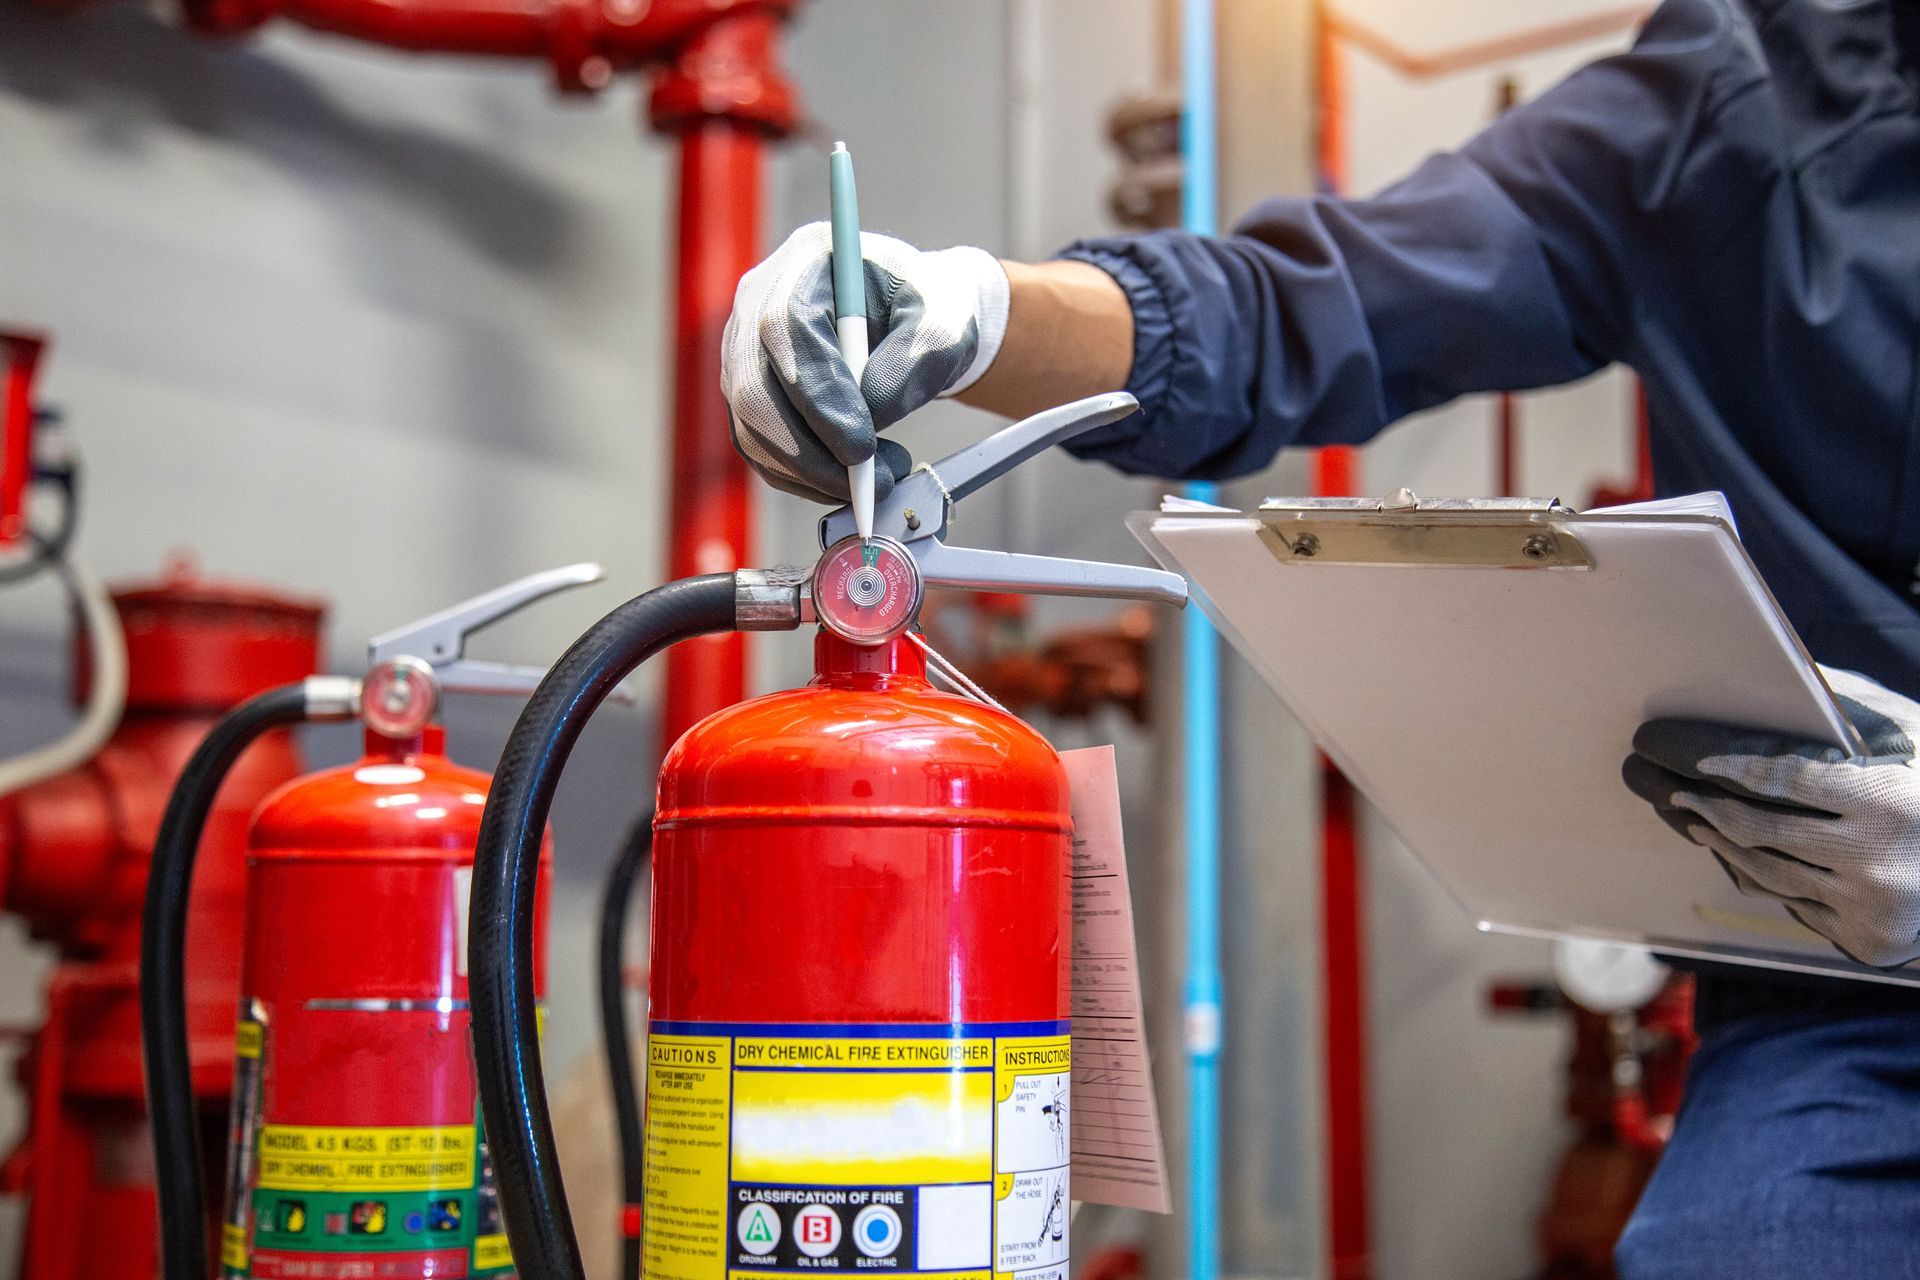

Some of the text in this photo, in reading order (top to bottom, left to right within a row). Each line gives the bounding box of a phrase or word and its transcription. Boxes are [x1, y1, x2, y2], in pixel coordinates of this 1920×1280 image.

[837, 564, 856, 600] RECHARGE
[879, 569, 898, 616] OVERCHARGED
[652, 1047, 717, 1064] CAUTIONS
[738, 1045, 989, 1060] DRY CHEMICAL FIRE EXTINGUISHER
[1005, 1049, 1070, 1065] INSTRUCTIONS
[674, 1071, 706, 1081] IMMEDIATELY
[1016, 1080, 1041, 1090] PULL OUT
[1016, 1092, 1036, 1101] SAFETY
[1016, 1105, 1026, 1113] PIN
[1003, 1182, 1008, 1190] 2
[1033, 1178, 1043, 1186] OUT
[738, 1190, 904, 1204] CLASSIFICATION OF FIRE
[1028, 1190, 1042, 1198] HOSE
[807, 1218, 828, 1242] B
[1001, 1241, 1037, 1253] START FROM
[739, 1256, 777, 1265] ORDINARY
[797, 1258, 839, 1267] OIL & GAS
[856, 1258, 897, 1267] ELECTRIC
[1006, 1256, 1021, 1265] FEET
[1022, 1254, 1036, 1263] BACK
